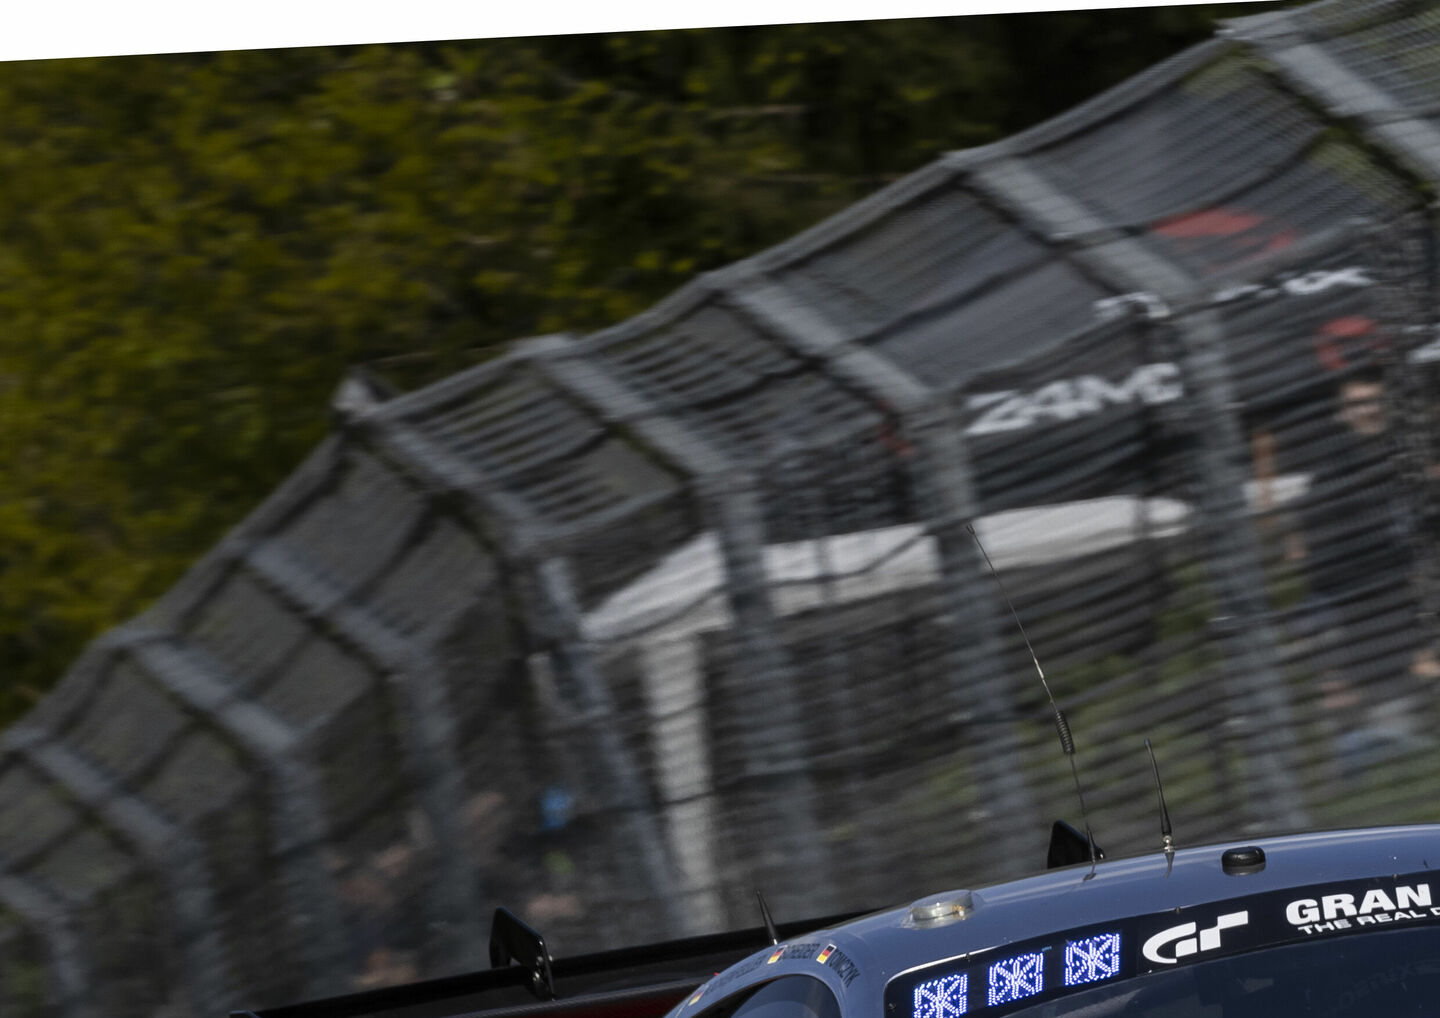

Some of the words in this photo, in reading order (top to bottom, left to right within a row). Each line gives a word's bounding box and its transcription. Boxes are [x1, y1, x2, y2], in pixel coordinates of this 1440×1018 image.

[1286, 884, 1432, 926] GRAN
[1298, 918, 1352, 935] THE
[1356, 910, 1427, 926] REAL
